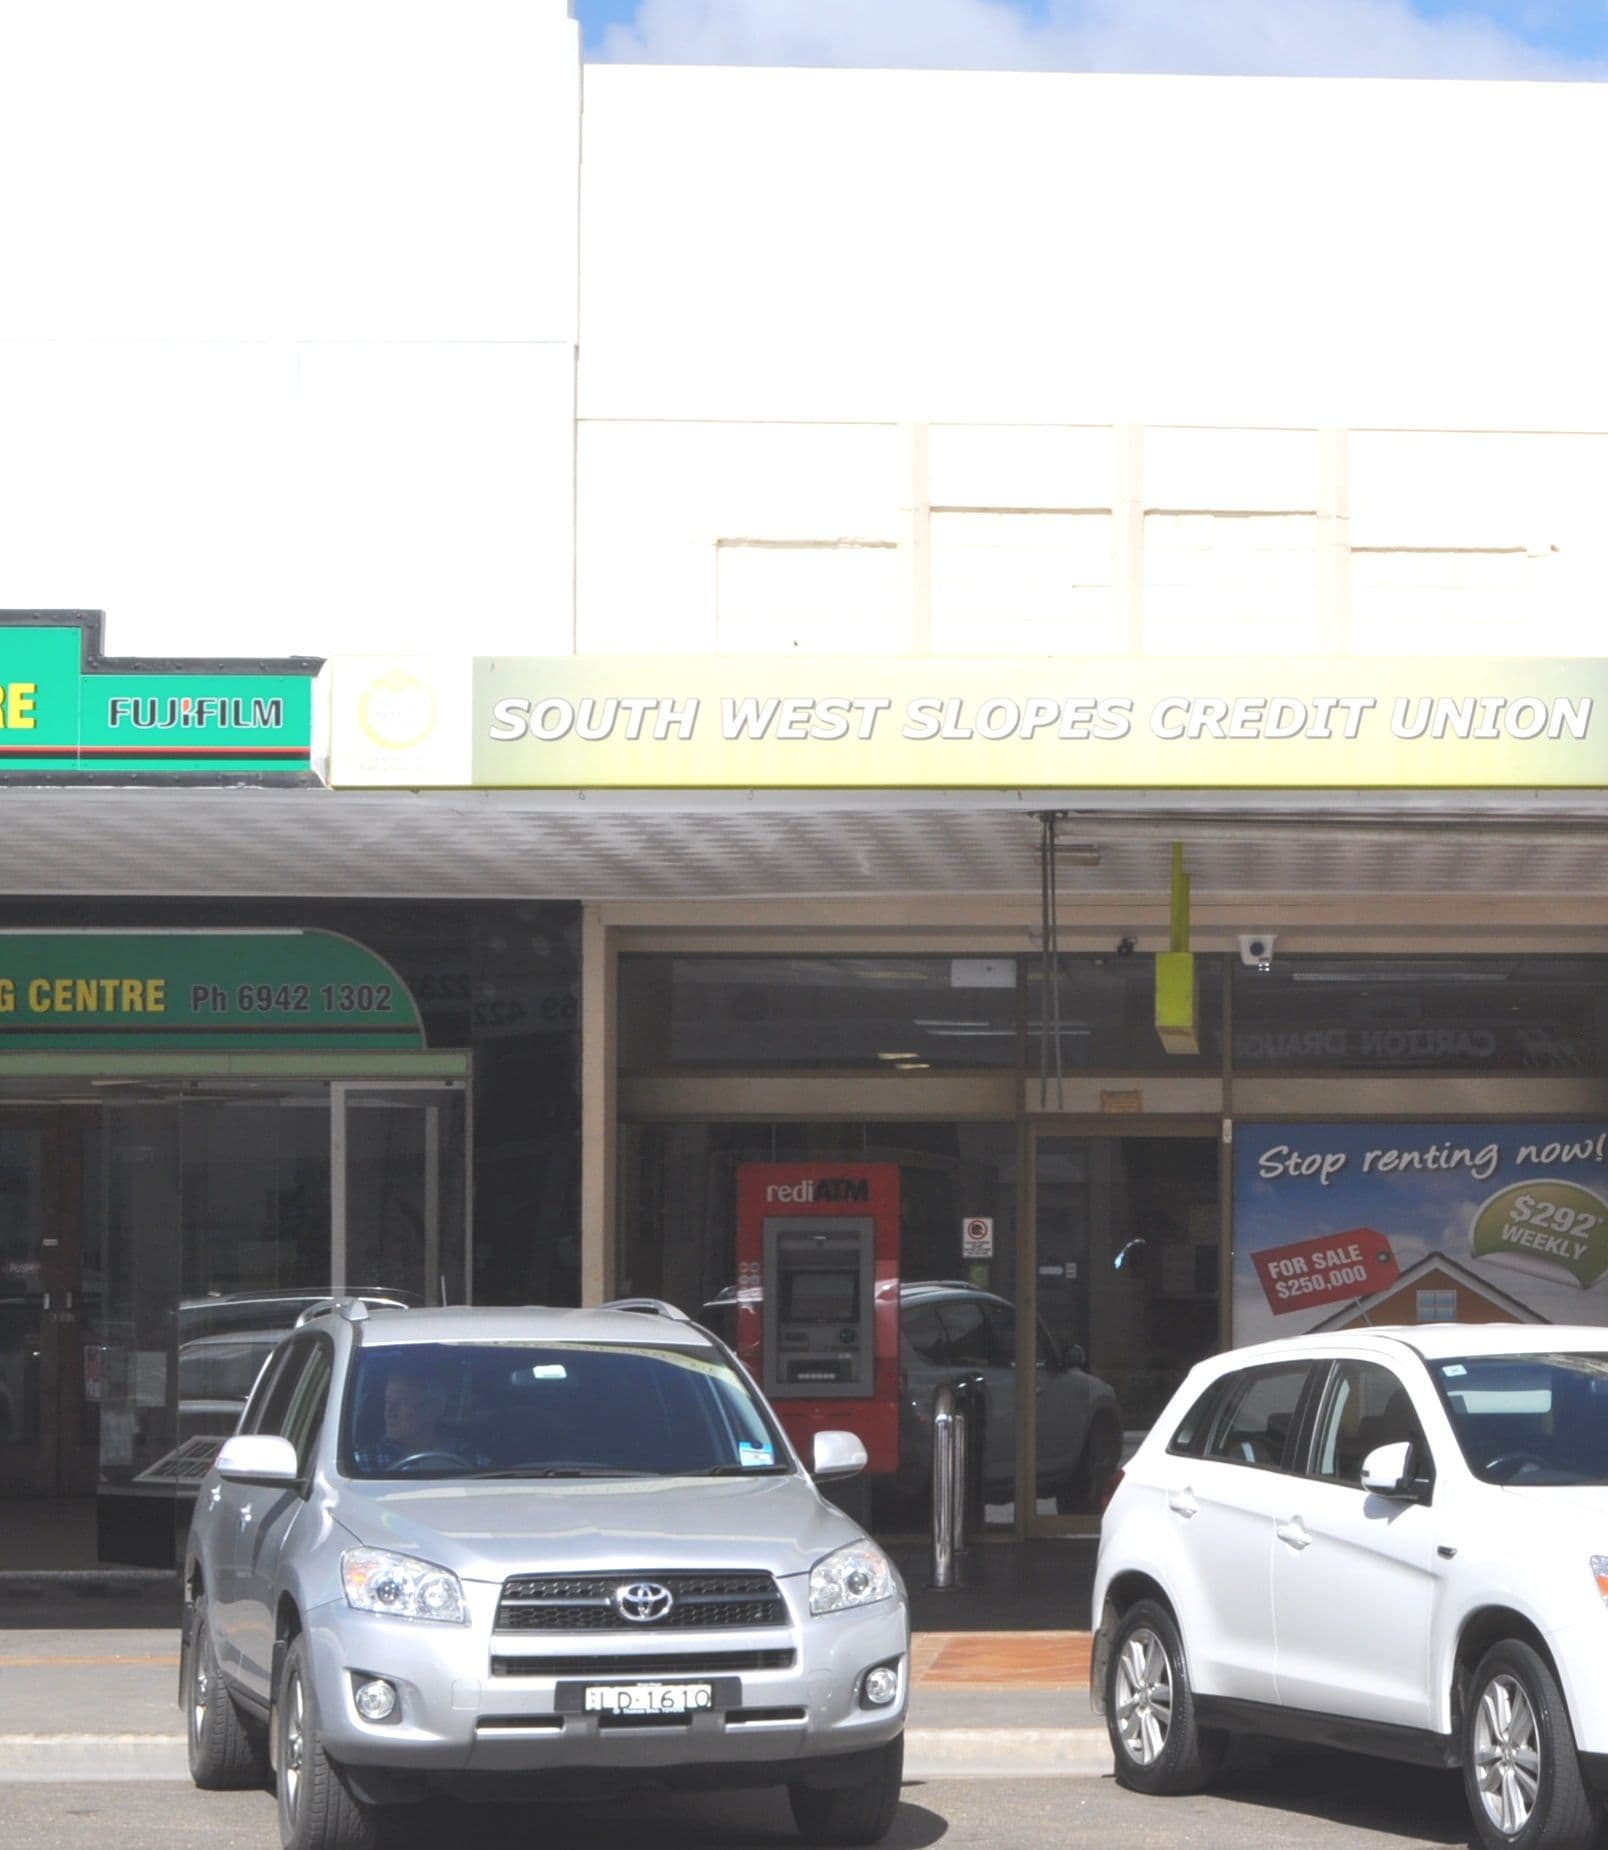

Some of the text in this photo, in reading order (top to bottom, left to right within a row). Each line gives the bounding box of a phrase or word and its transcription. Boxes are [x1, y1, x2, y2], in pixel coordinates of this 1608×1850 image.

[0, 683, 36, 728] E
[108, 697, 283, 728] FUJIFILM
[488, 696, 1594, 741] SOUTH WEST SLOPES CREDIT UNION
[28, 978, 166, 1013] CENTRE
[191, 984, 227, 1012] Ph
[237, 984, 309, 1012] 6942
[321, 984, 392, 1012] 1302
[1258, 1133, 1606, 1185] Stop renting now!
[766, 1179, 870, 1202] rediATM
[1500, 1223, 1589, 1262] WEEKLY
[1267, 1244, 1363, 1280] FOR SALE
[1274, 1265, 1368, 1300] $250,000
